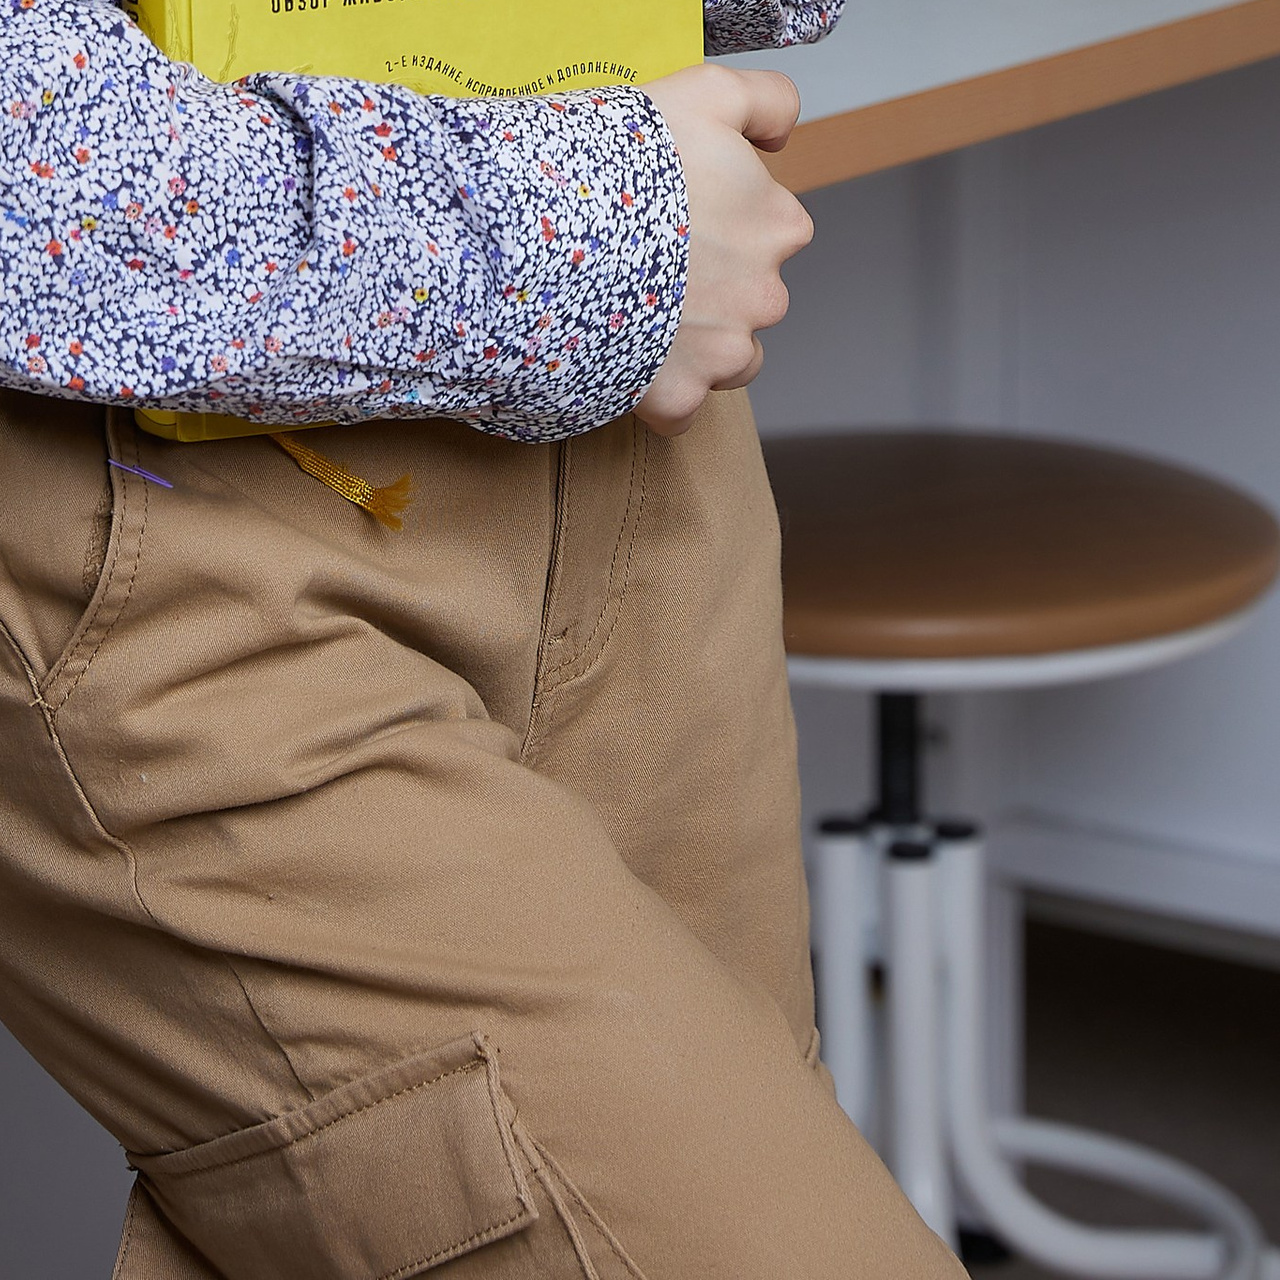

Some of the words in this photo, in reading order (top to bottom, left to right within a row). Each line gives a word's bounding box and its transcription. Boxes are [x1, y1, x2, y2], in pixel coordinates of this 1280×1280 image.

[385, 55, 408, 73] 2-Е
[412, 55, 463, 86] ИЗДАНИЕ,
[546, 74, 555, 86] И
[556, 61, 638, 84] ДОПОЛНЕННОЕ
